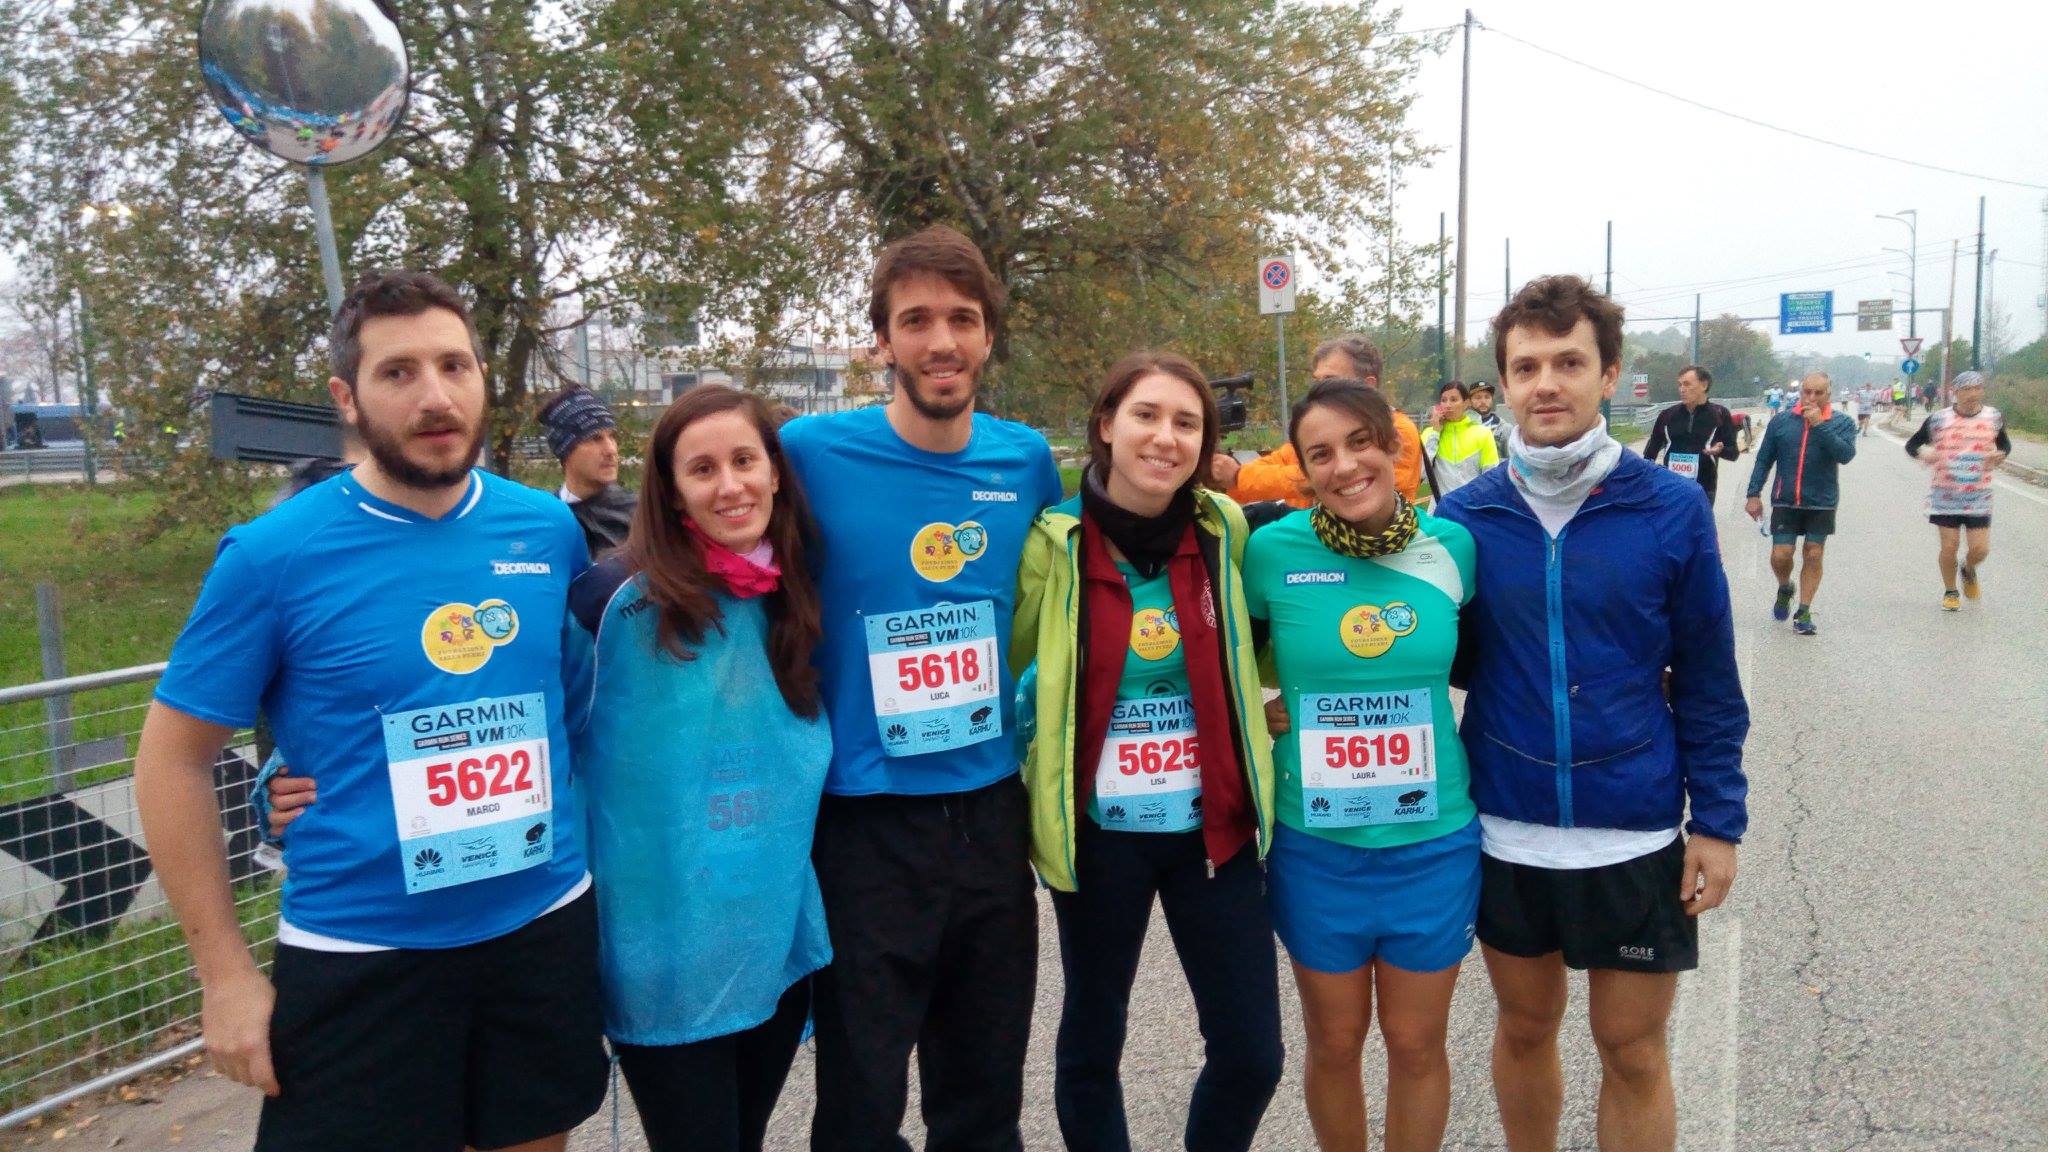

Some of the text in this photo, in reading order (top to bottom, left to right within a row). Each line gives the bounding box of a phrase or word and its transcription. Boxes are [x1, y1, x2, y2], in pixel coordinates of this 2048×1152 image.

[1672, 463, 1692, 472] 5006
[973, 490, 1017, 502] DECATHLON
[494, 562, 551, 575] DECATHLON
[1286, 572, 1345, 584] DECATHLON
[885, 607, 977, 632] GARMIN
[936, 628, 959, 643] VM
[960, 625, 978, 639] 10K
[898, 648, 979, 691] 5618
[930, 691, 950, 701] LUCA
[1112, 699, 1195, 719] GARMIN
[1317, 694, 1409, 712] GARMIN
[411, 700, 525, 734] GARMIN
[1363, 714, 1388, 726] VM
[1390, 712, 1409, 724] 10K
[968, 722, 993, 736] KARHU
[1157, 719, 1179, 731] VM
[476, 726, 504, 743] VM
[505, 722, 527, 740] 10K
[921, 729, 950, 738] VENICE
[1119, 737, 1200, 776] 5625
[1326, 733, 1410, 769] 5619
[426, 750, 533, 807] 5622
[1352, 771, 1377, 779] LAURA
[1150, 778, 1167, 786] LISA
[466, 803, 501, 817] MARCO
[1344, 805, 1371, 813] VENICE
[1394, 805, 1427, 816] KARHU
[461, 850, 497, 862] VENICE
[1620, 946, 1654, 956] GORE
